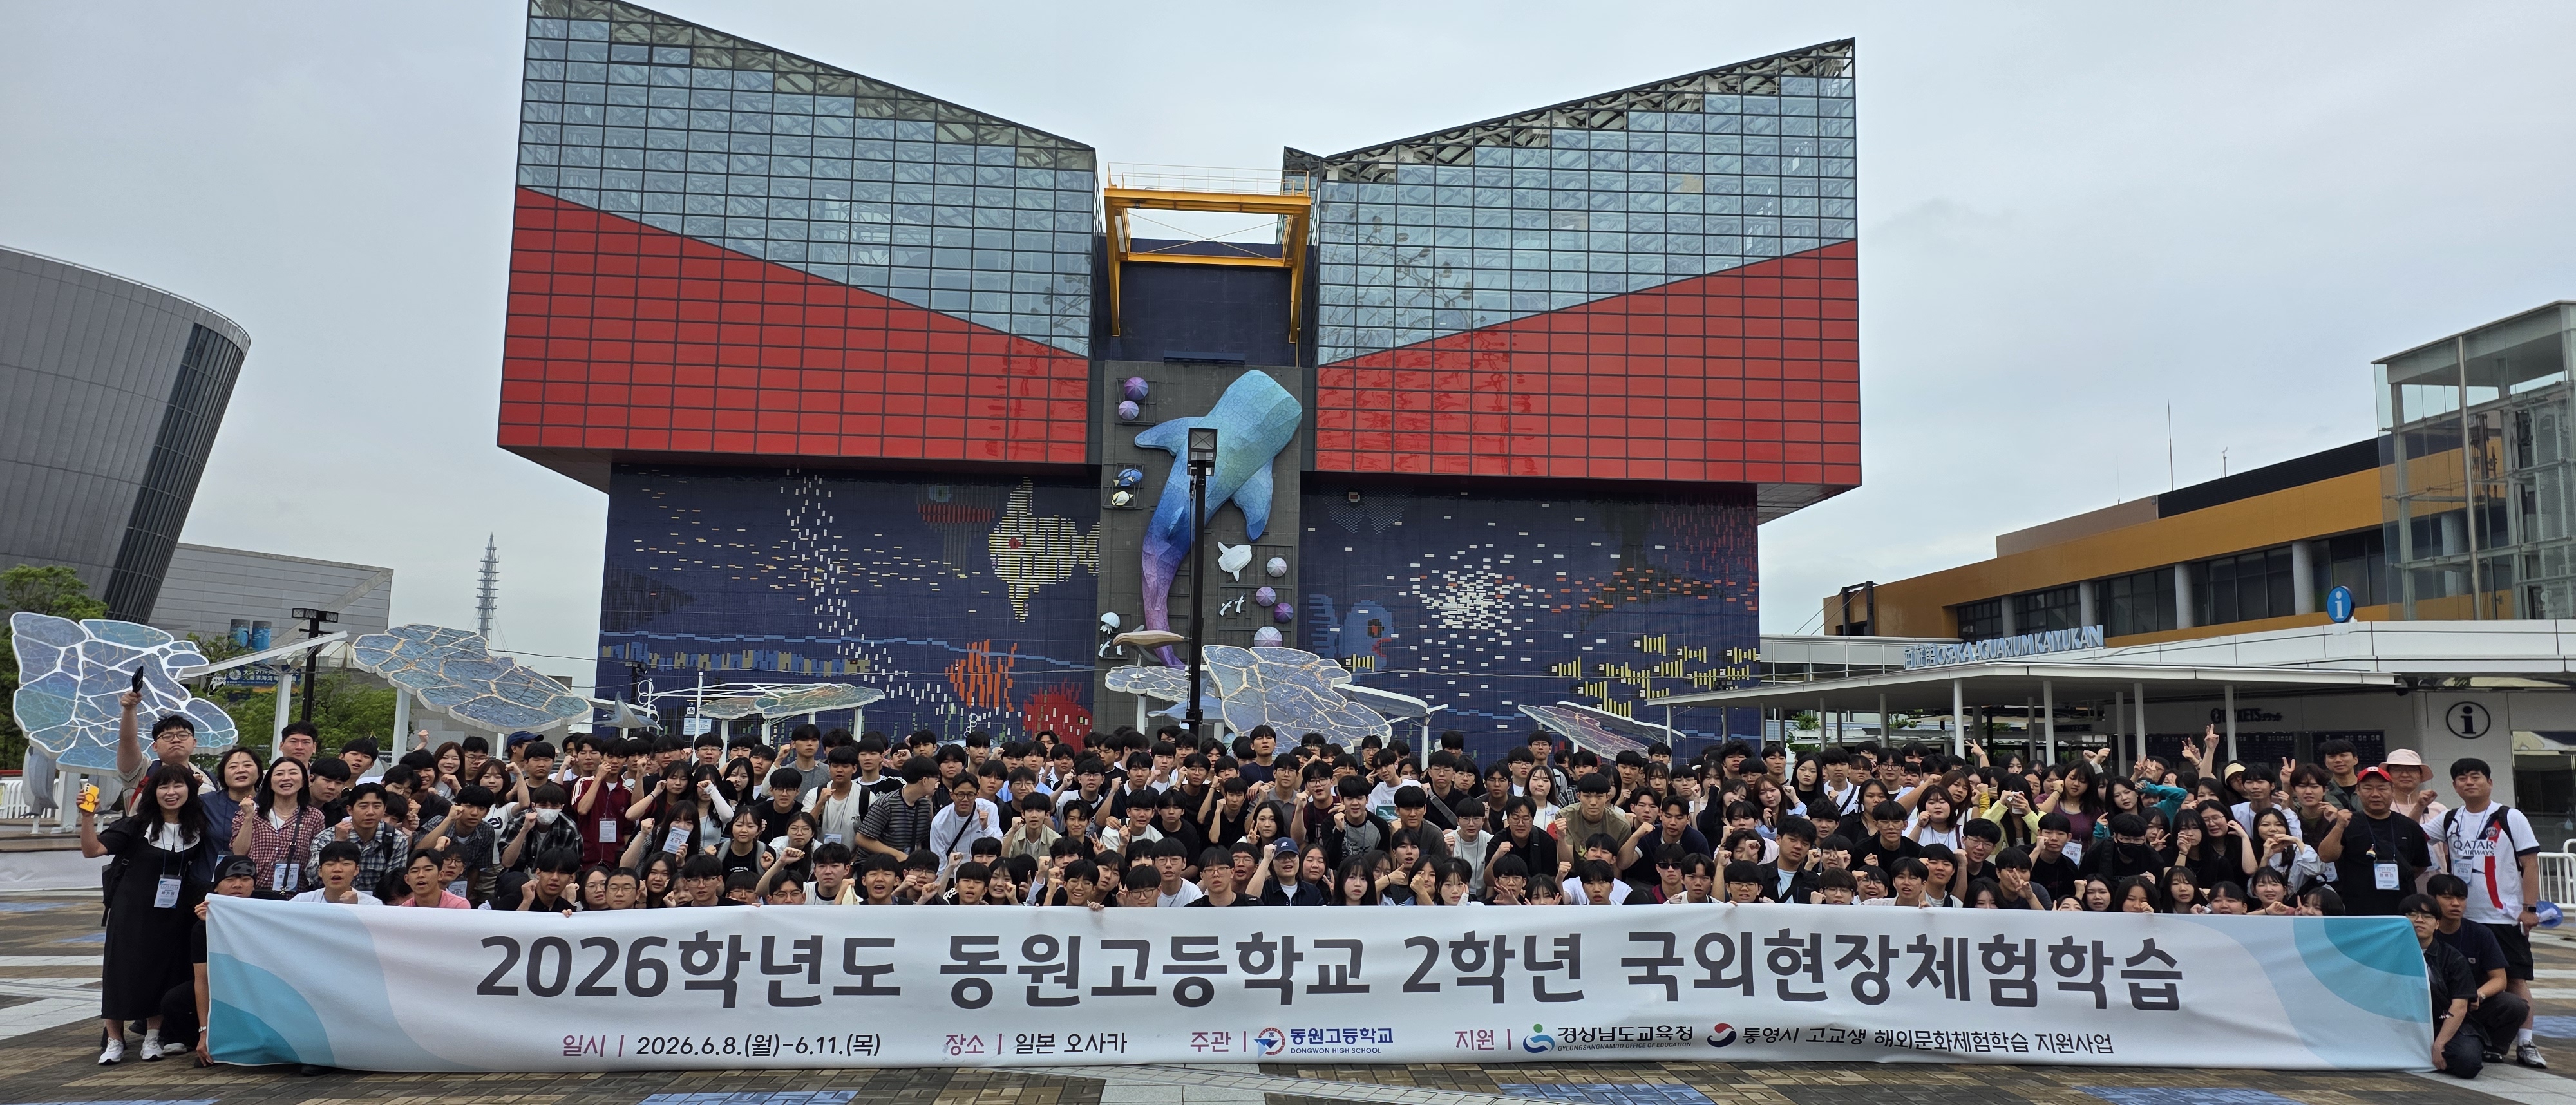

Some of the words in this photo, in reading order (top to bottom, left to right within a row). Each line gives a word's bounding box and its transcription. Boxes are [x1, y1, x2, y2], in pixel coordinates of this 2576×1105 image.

[1937, 642, 1975, 665] OSAKA
[1975, 634, 2035, 659] AQUARIUM
[2035, 625, 2103, 653] KAIYUKAN
[2453, 840, 2494, 851] QATAR
[477, 930, 902, 1008] 2026학년도
[940, 931, 1370, 1010] 동원고등학교
[1403, 930, 1585, 1004] 2학년
[1621, 928, 2183, 1011] 국외현장체험학습
[945, 1034, 985, 1056] 장소
[1016, 1033, 1056, 1054] 일본
[1063, 1032, 1128, 1054] 오사카
[1190, 1032, 1231, 1053] 주관
[1290, 1028, 1394, 1045] 동원고등학교
[1455, 1029, 1495, 1051] 지원
[1558, 1025, 1694, 1043] 경상남도교육청
[1742, 1027, 1800, 1044] 통영시
[1805, 1028, 1866, 1045] 고교생
[1874, 1030, 2029, 1052] 해외문화체험학습
[2034, 1033, 2114, 1054] 지원사업
[564, 1035, 606, 1057] 일시
[636, 1034, 881, 1057] 2026.6.8.(월)-6.11.(목)
[1558, 1043, 1624, 1052] GYEONGSANGNAMDO
